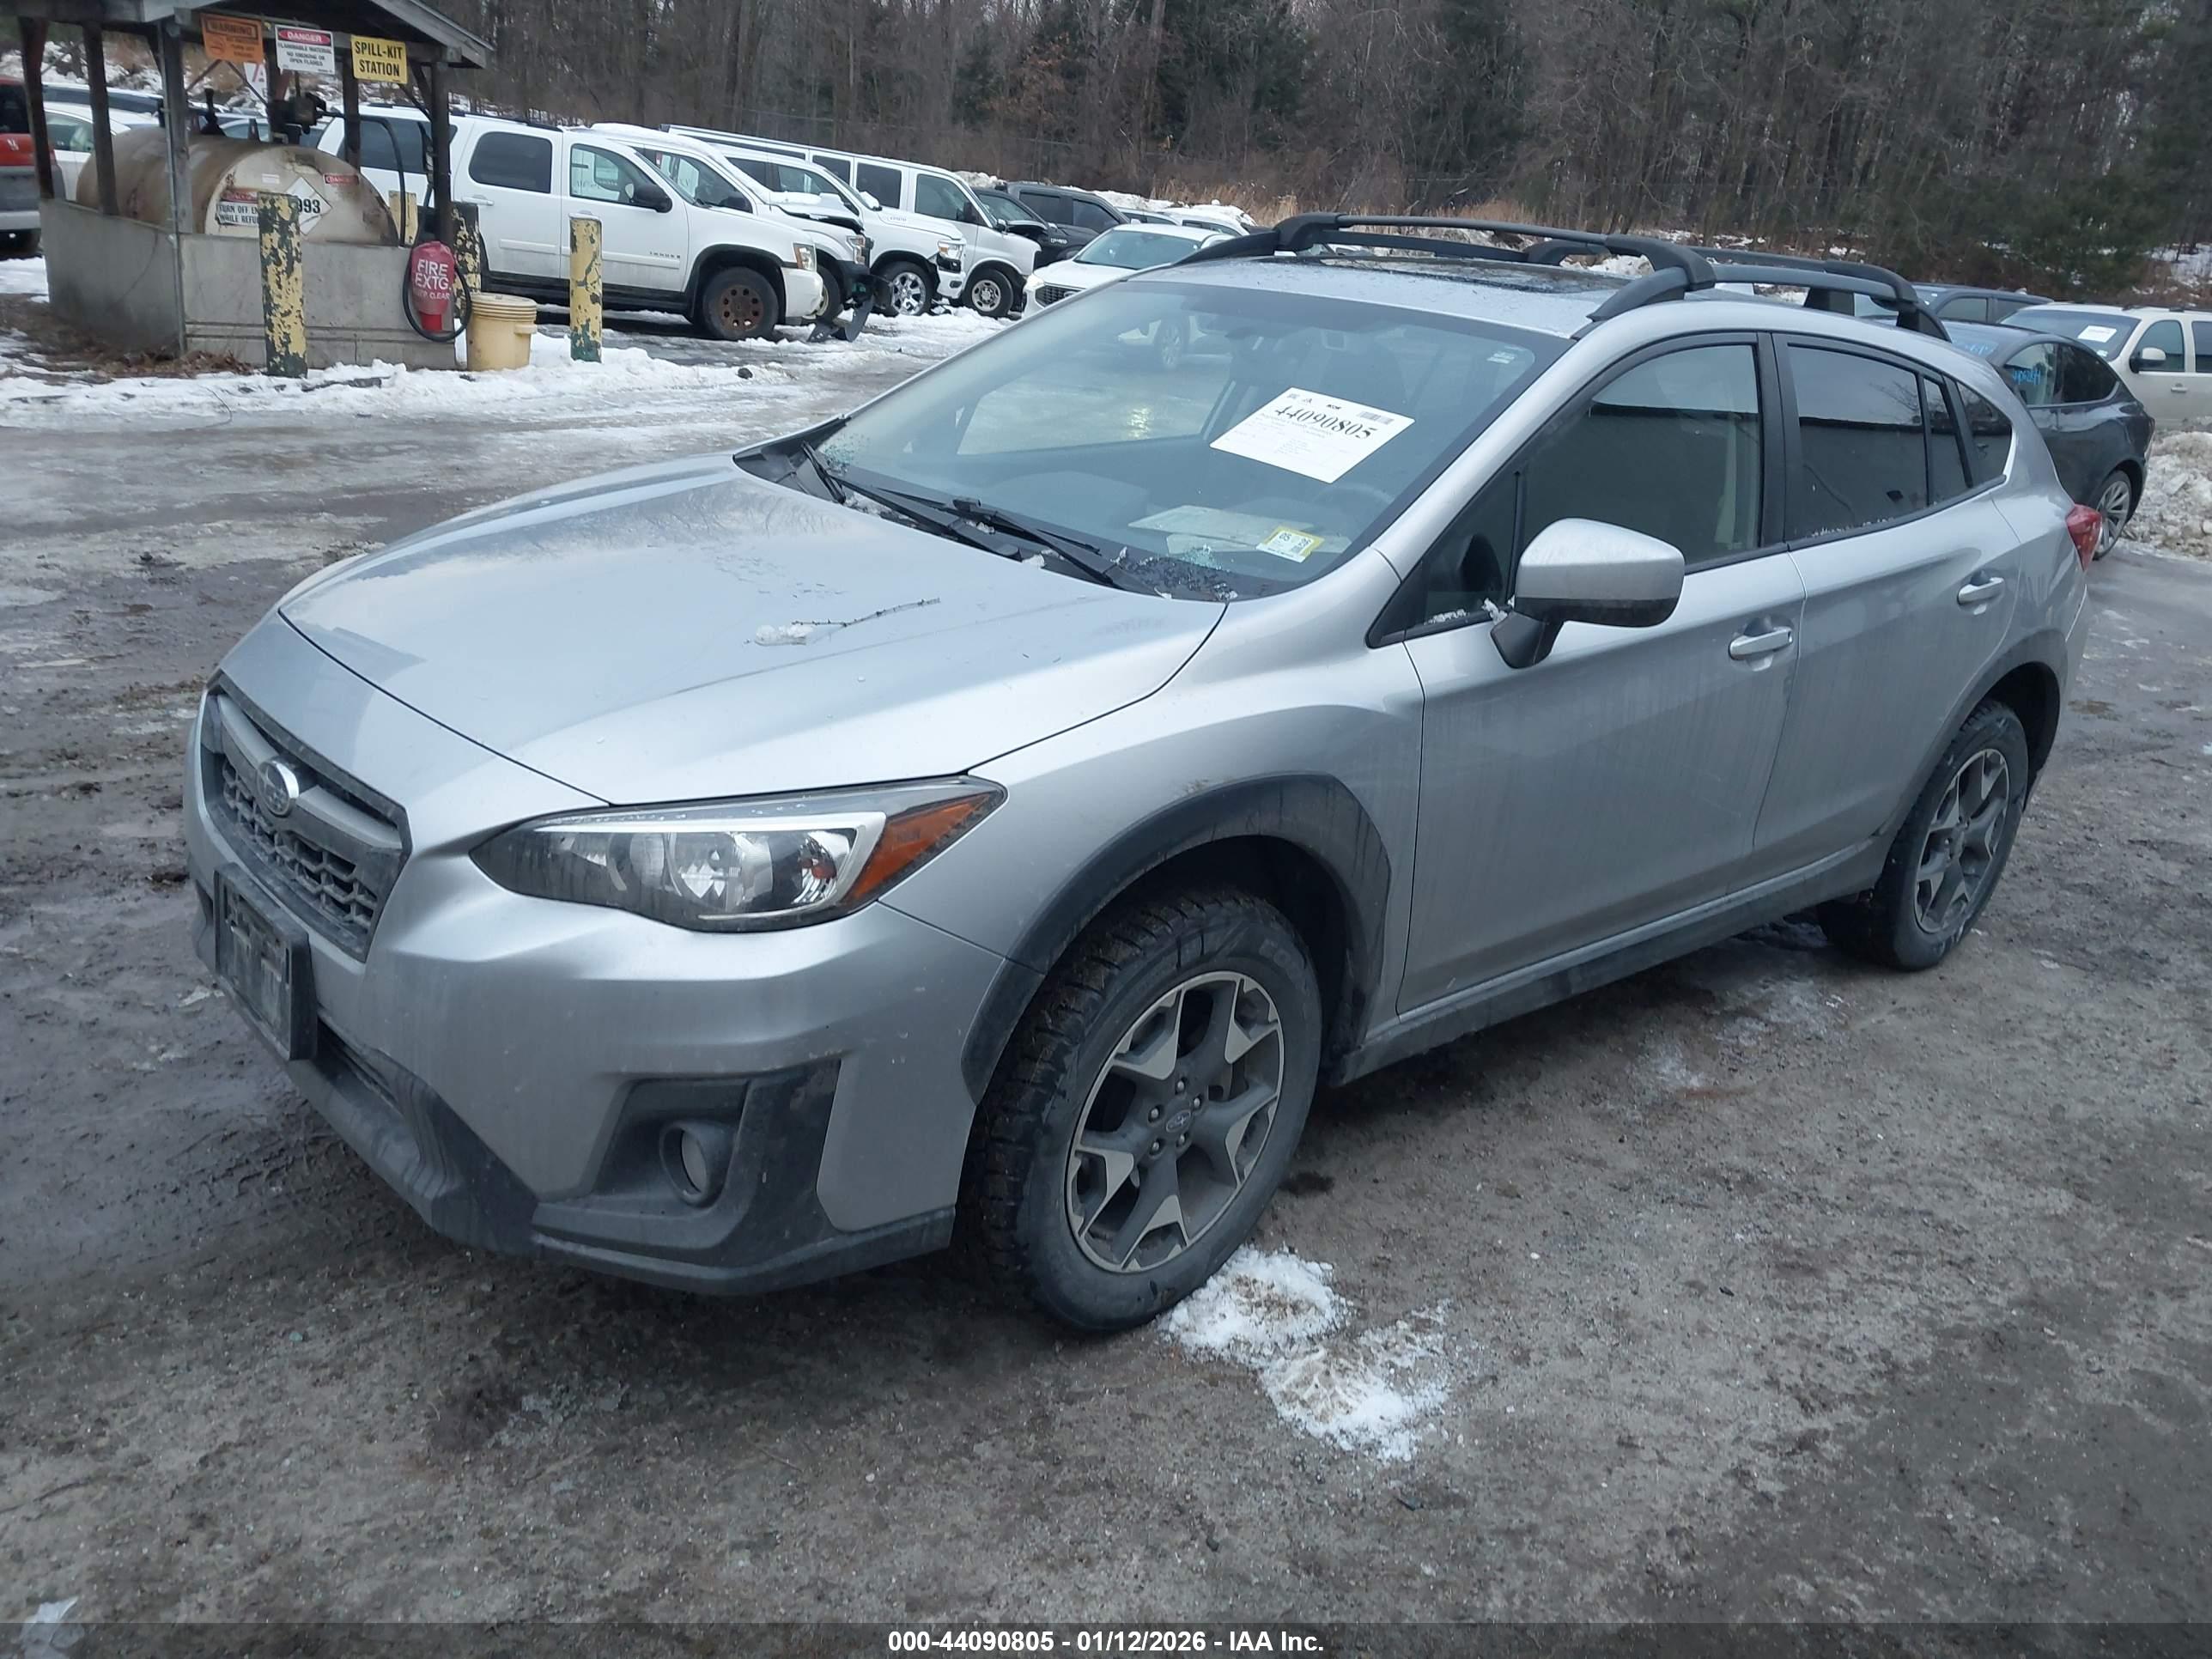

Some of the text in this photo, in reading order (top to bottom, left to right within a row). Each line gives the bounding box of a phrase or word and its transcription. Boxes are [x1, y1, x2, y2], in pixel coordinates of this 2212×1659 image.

[287, 31, 322, 42] DANGER
[355, 41, 403, 59] SPILL-KIT
[359, 59, 400, 76] STATION
[417, 258, 448, 276] FIRE
[415, 272, 452, 290] EXTG.
[1275, 404, 1378, 439] 44090805
